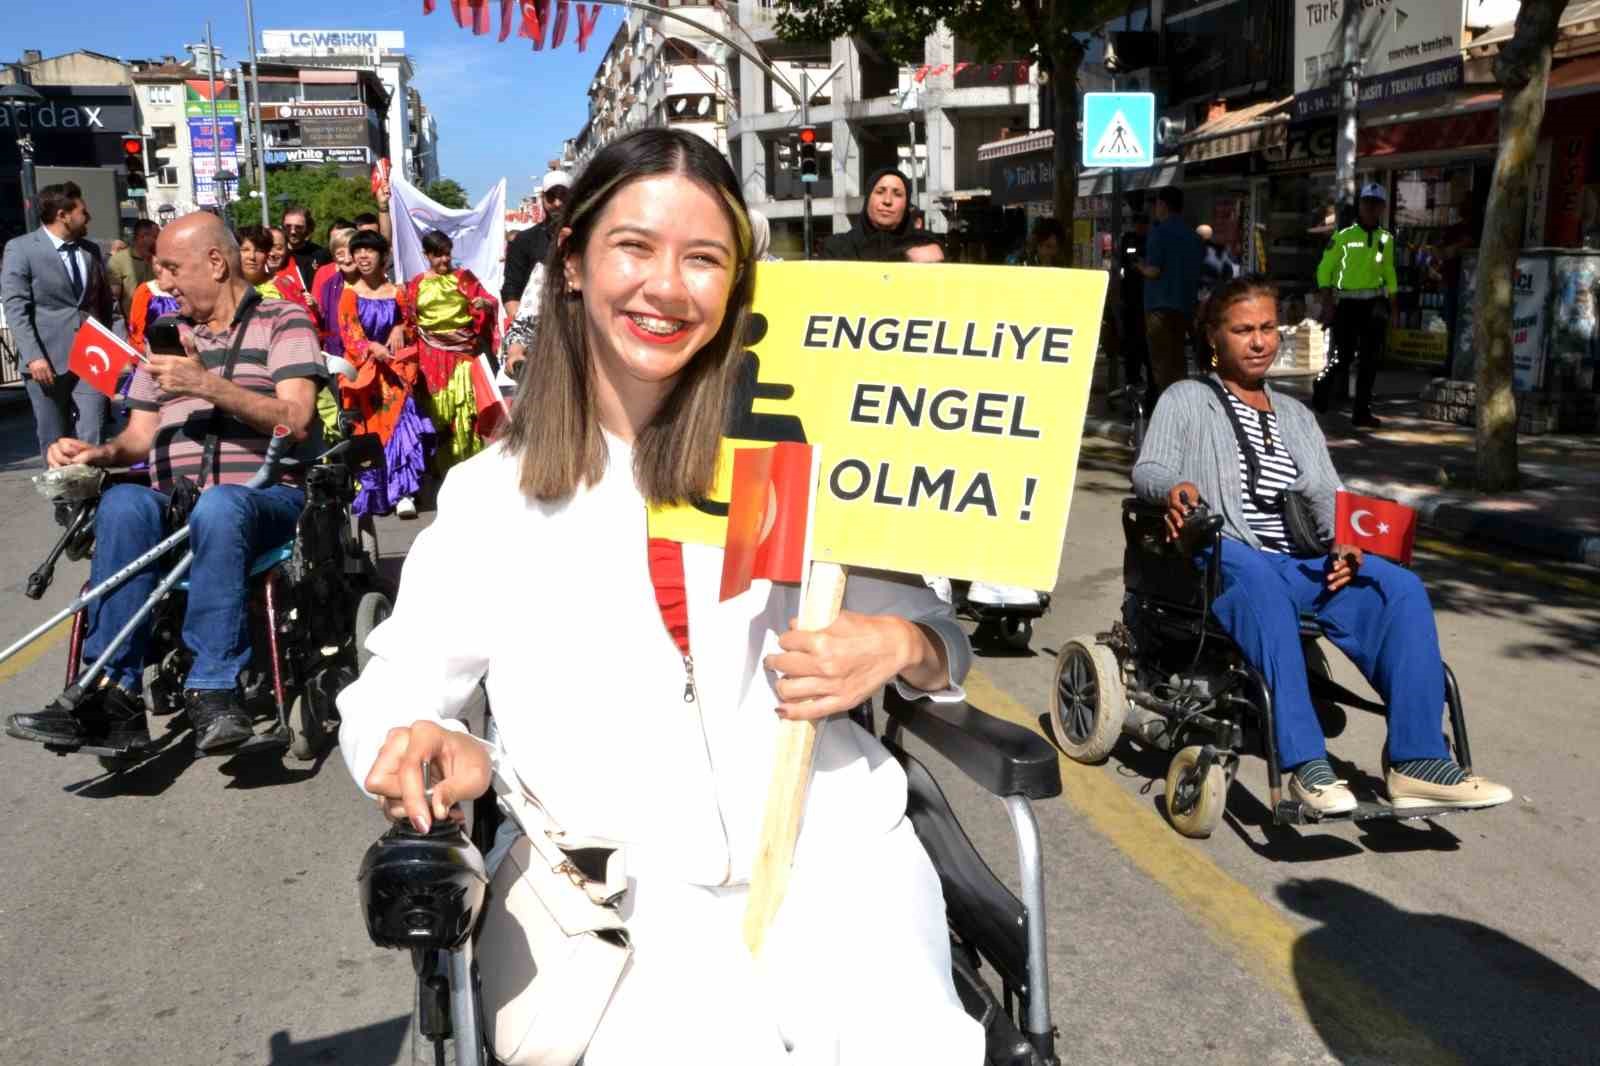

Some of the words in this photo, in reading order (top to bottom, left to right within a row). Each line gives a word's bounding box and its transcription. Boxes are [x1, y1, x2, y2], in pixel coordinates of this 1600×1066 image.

[804, 315, 1073, 363] ENGELLiYE
[850, 383, 1040, 438] ENGEL
[829, 459, 997, 516] OLMA
[1020, 477, 1038, 520] !
